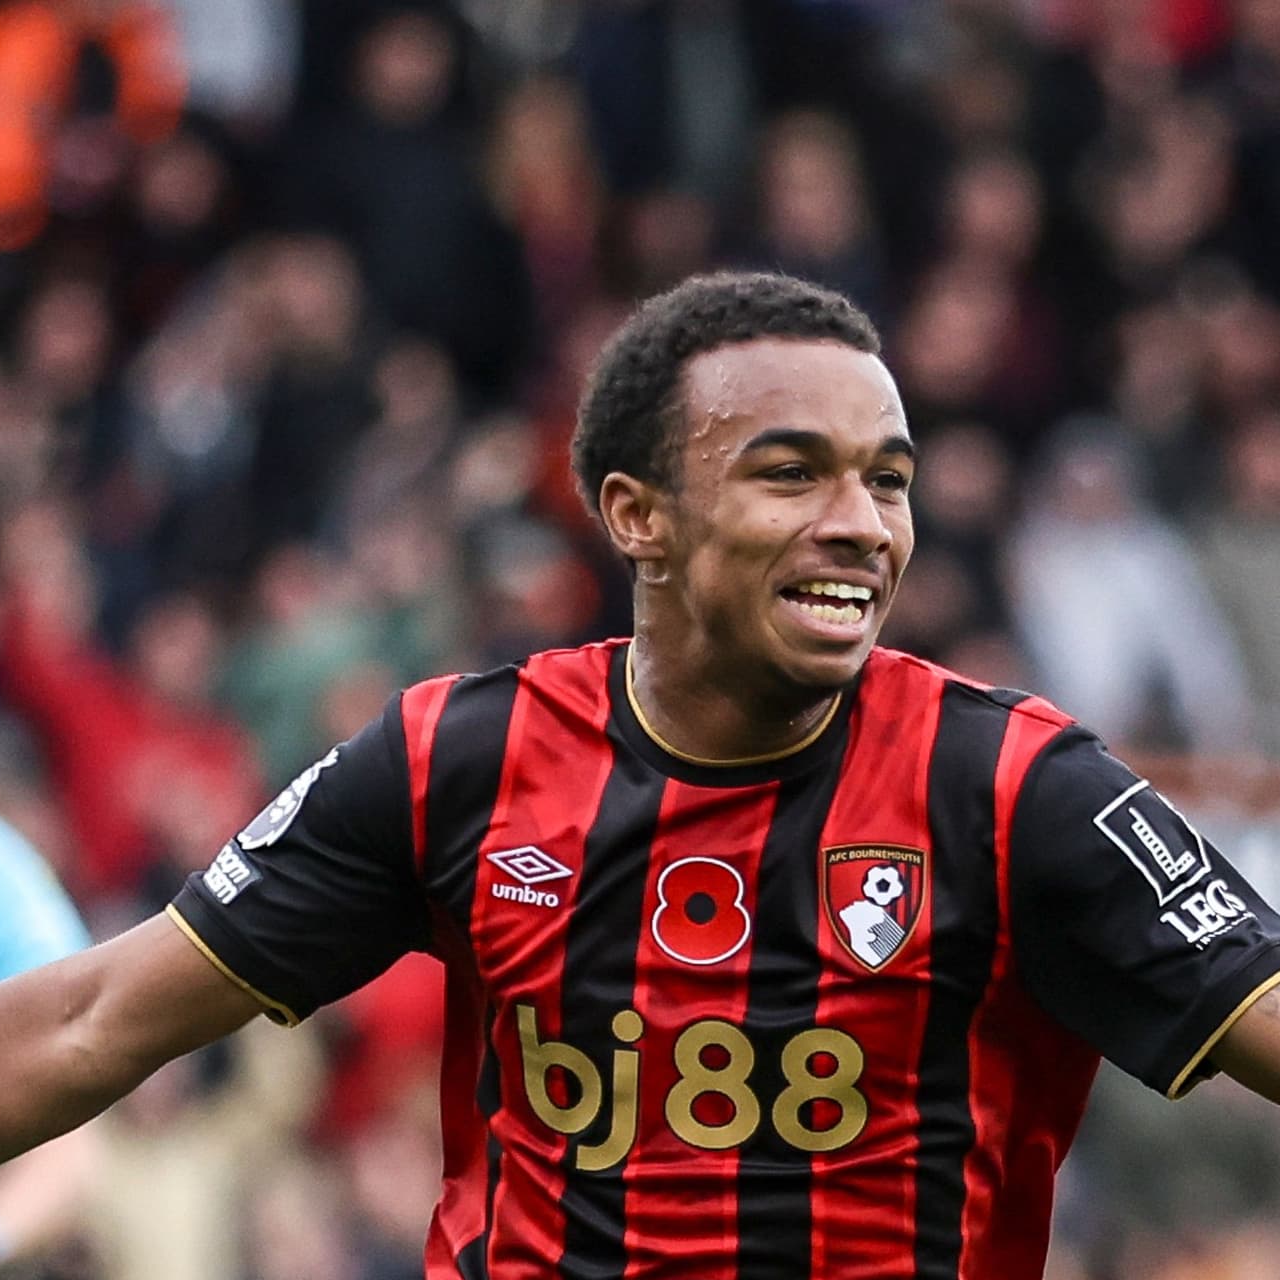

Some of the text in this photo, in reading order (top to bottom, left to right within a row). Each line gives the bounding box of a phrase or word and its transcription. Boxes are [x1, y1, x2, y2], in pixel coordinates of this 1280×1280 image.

[828, 851, 847, 864] AFC
[492, 883, 559, 908] umbro
[516, 1003, 868, 1171] bj88
